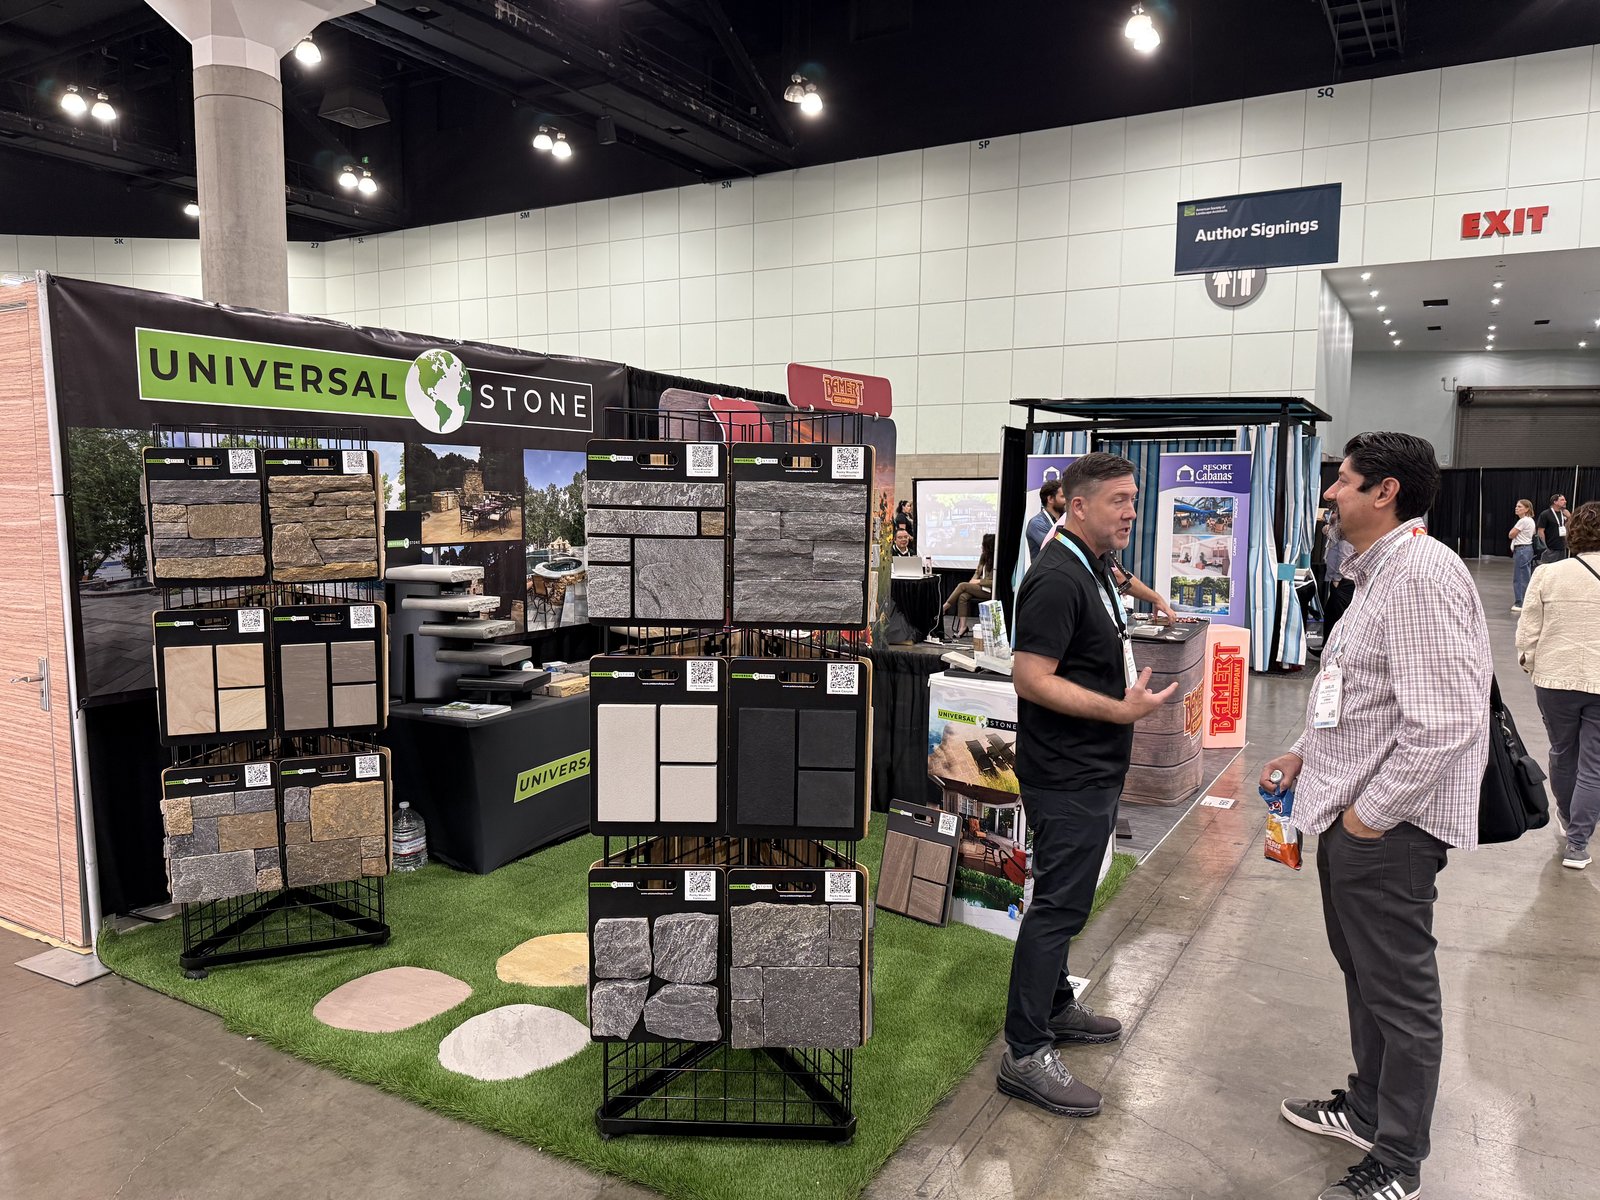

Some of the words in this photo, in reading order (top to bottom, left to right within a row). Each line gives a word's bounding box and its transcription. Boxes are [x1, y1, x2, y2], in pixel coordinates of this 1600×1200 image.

[1317, 87, 1334, 98] SQ
[978, 140, 990, 150] SP
[721, 181, 732, 189] SN
[1195, 226, 1248, 242] Author
[1250, 220, 1319, 238] Signings
[1461, 206, 1549, 239] EXIT
[150, 348, 398, 400] UNIVERSAL
[480, 384, 587, 417] STONE
[1196, 470, 1233, 481] Cabanas
[1209, 642, 1240, 736] BAMERT
[1233, 663, 1241, 696] COMPANY
[938, 711, 975, 723] UNIVERSAL
[990, 720, 1017, 730] STONE
